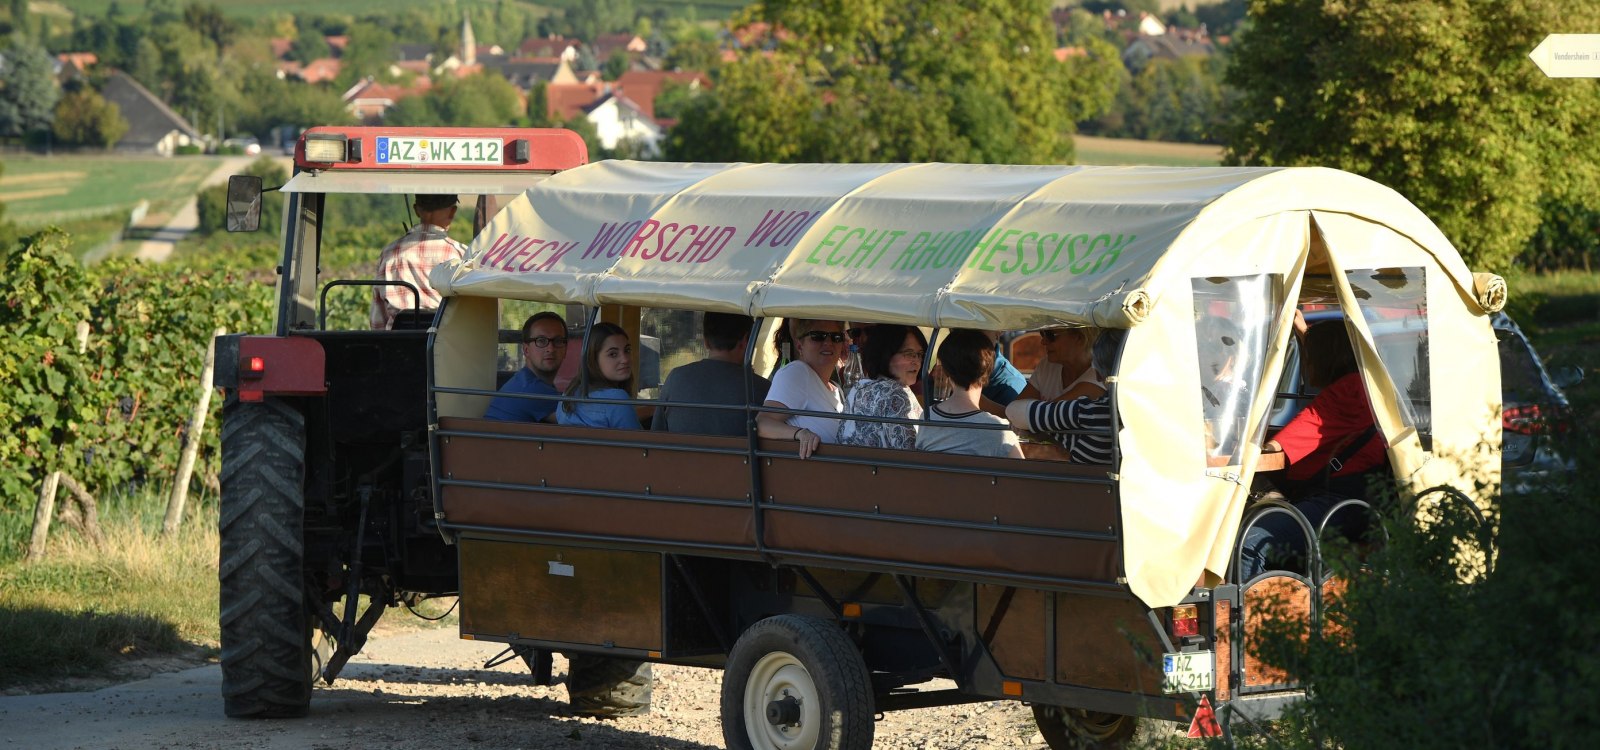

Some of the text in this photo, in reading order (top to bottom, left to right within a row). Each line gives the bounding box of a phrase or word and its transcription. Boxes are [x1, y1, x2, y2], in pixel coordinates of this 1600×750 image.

[389, 141, 415, 160] AZ
[430, 142, 456, 161] WK
[461, 142, 499, 161] 112
[480, 233, 580, 272] WECK
[580, 218, 737, 263] WORSCHD
[805, 225, 907, 269] ECHT
[1176, 656, 1192, 671] AZ
[1188, 672, 1211, 688] 211
